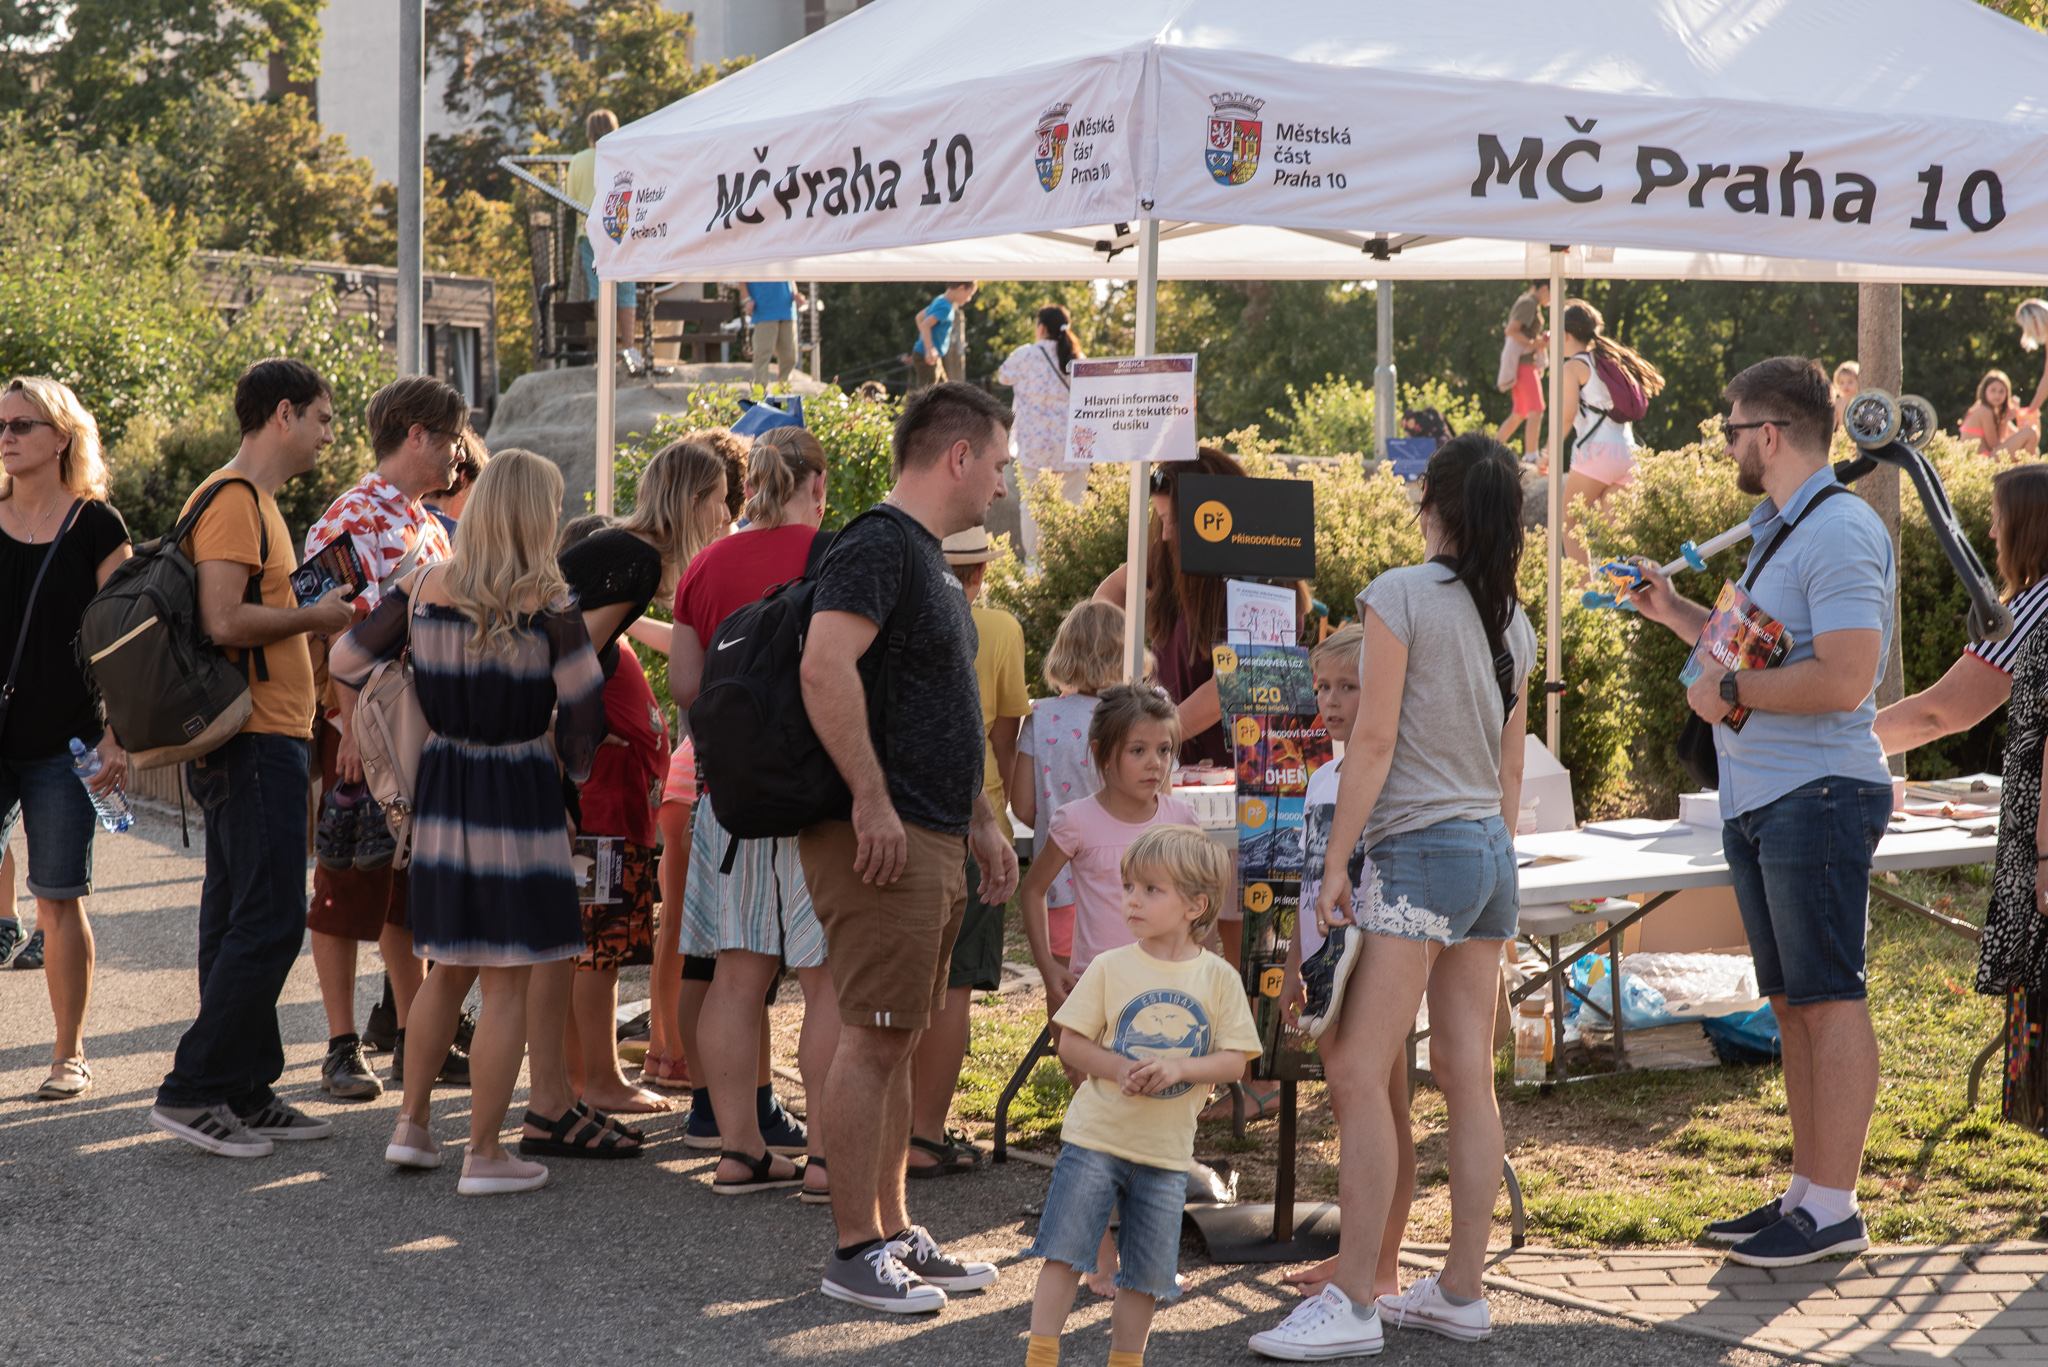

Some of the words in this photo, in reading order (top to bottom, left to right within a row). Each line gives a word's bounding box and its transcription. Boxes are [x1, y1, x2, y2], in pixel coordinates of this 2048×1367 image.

[1276, 122, 1351, 145] Městská
[1073, 142, 1094, 162] část
[1274, 145, 1312, 165] část
[1100, 162, 1111, 180] 10
[1273, 169, 1321, 188] Praha
[1327, 172, 1348, 189] 10
[1471, 116, 1604, 204] MČ
[1630, 146, 1877, 225] Praha
[1910, 164, 2006, 234] 10
[705, 146, 771, 233] MČ
[774, 146, 901, 220] Praha
[920, 134, 974, 206] 10
[658, 222, 668, 238] 10
[1084, 394, 1120, 406] Hlavní
[1122, 393, 1179, 406] informace
[1074, 408, 1125, 420] Zmrzlina
[1128, 409, 1134, 417] z
[1136, 404, 1189, 417] tekutého
[1112, 420, 1150, 431] dusíku
[1203, 512, 1225, 530] Př
[1231, 532, 1302, 548] PŘÍRODOVĚDCI.CZ
[1217, 653, 1232, 666] Př
[1712, 640, 1742, 672] OHEŇ
[1248, 686, 1282, 703] 120
[1241, 724, 1256, 738] Př
[1265, 765, 1308, 785] OHEŇ
[1248, 806, 1262, 820] Př
[1252, 890, 1268, 904] Př
[1267, 975, 1282, 989] Př
[1141, 992, 1162, 1007] EST
